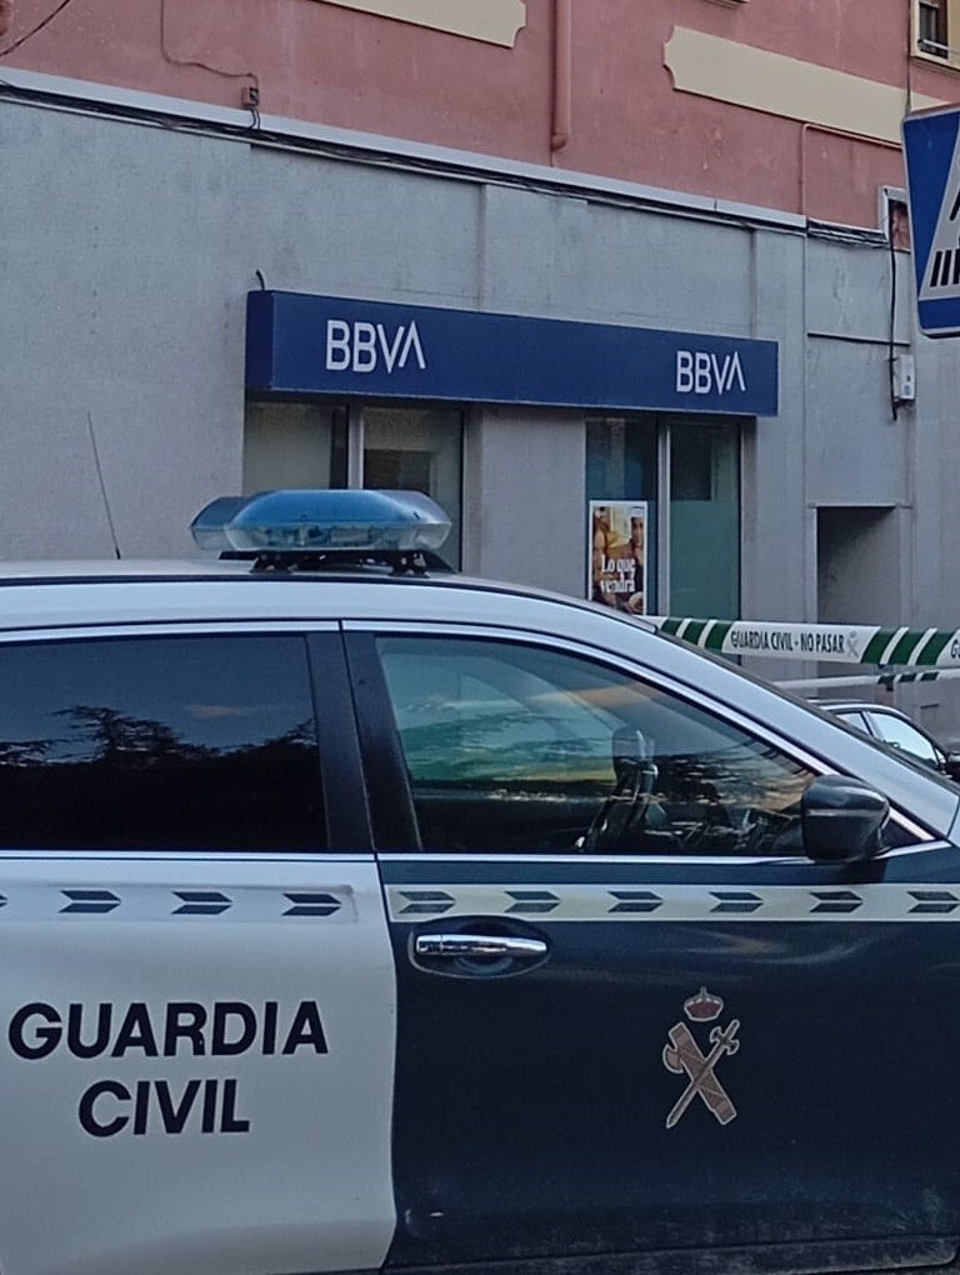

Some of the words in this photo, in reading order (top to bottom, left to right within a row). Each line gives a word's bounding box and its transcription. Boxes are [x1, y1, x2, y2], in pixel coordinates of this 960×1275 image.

[325, 319, 426, 373] BBVA
[675, 350, 746, 395] BBVA
[730, 630, 770, 651] GUARDIA
[770, 632, 793, 652] CIVIL
[800, 633, 814, 653] NO
[816, 633, 845, 653] PASAR
[8, 1001, 329, 1060] GUARDIA
[78, 1079, 250, 1137] CIVIL
